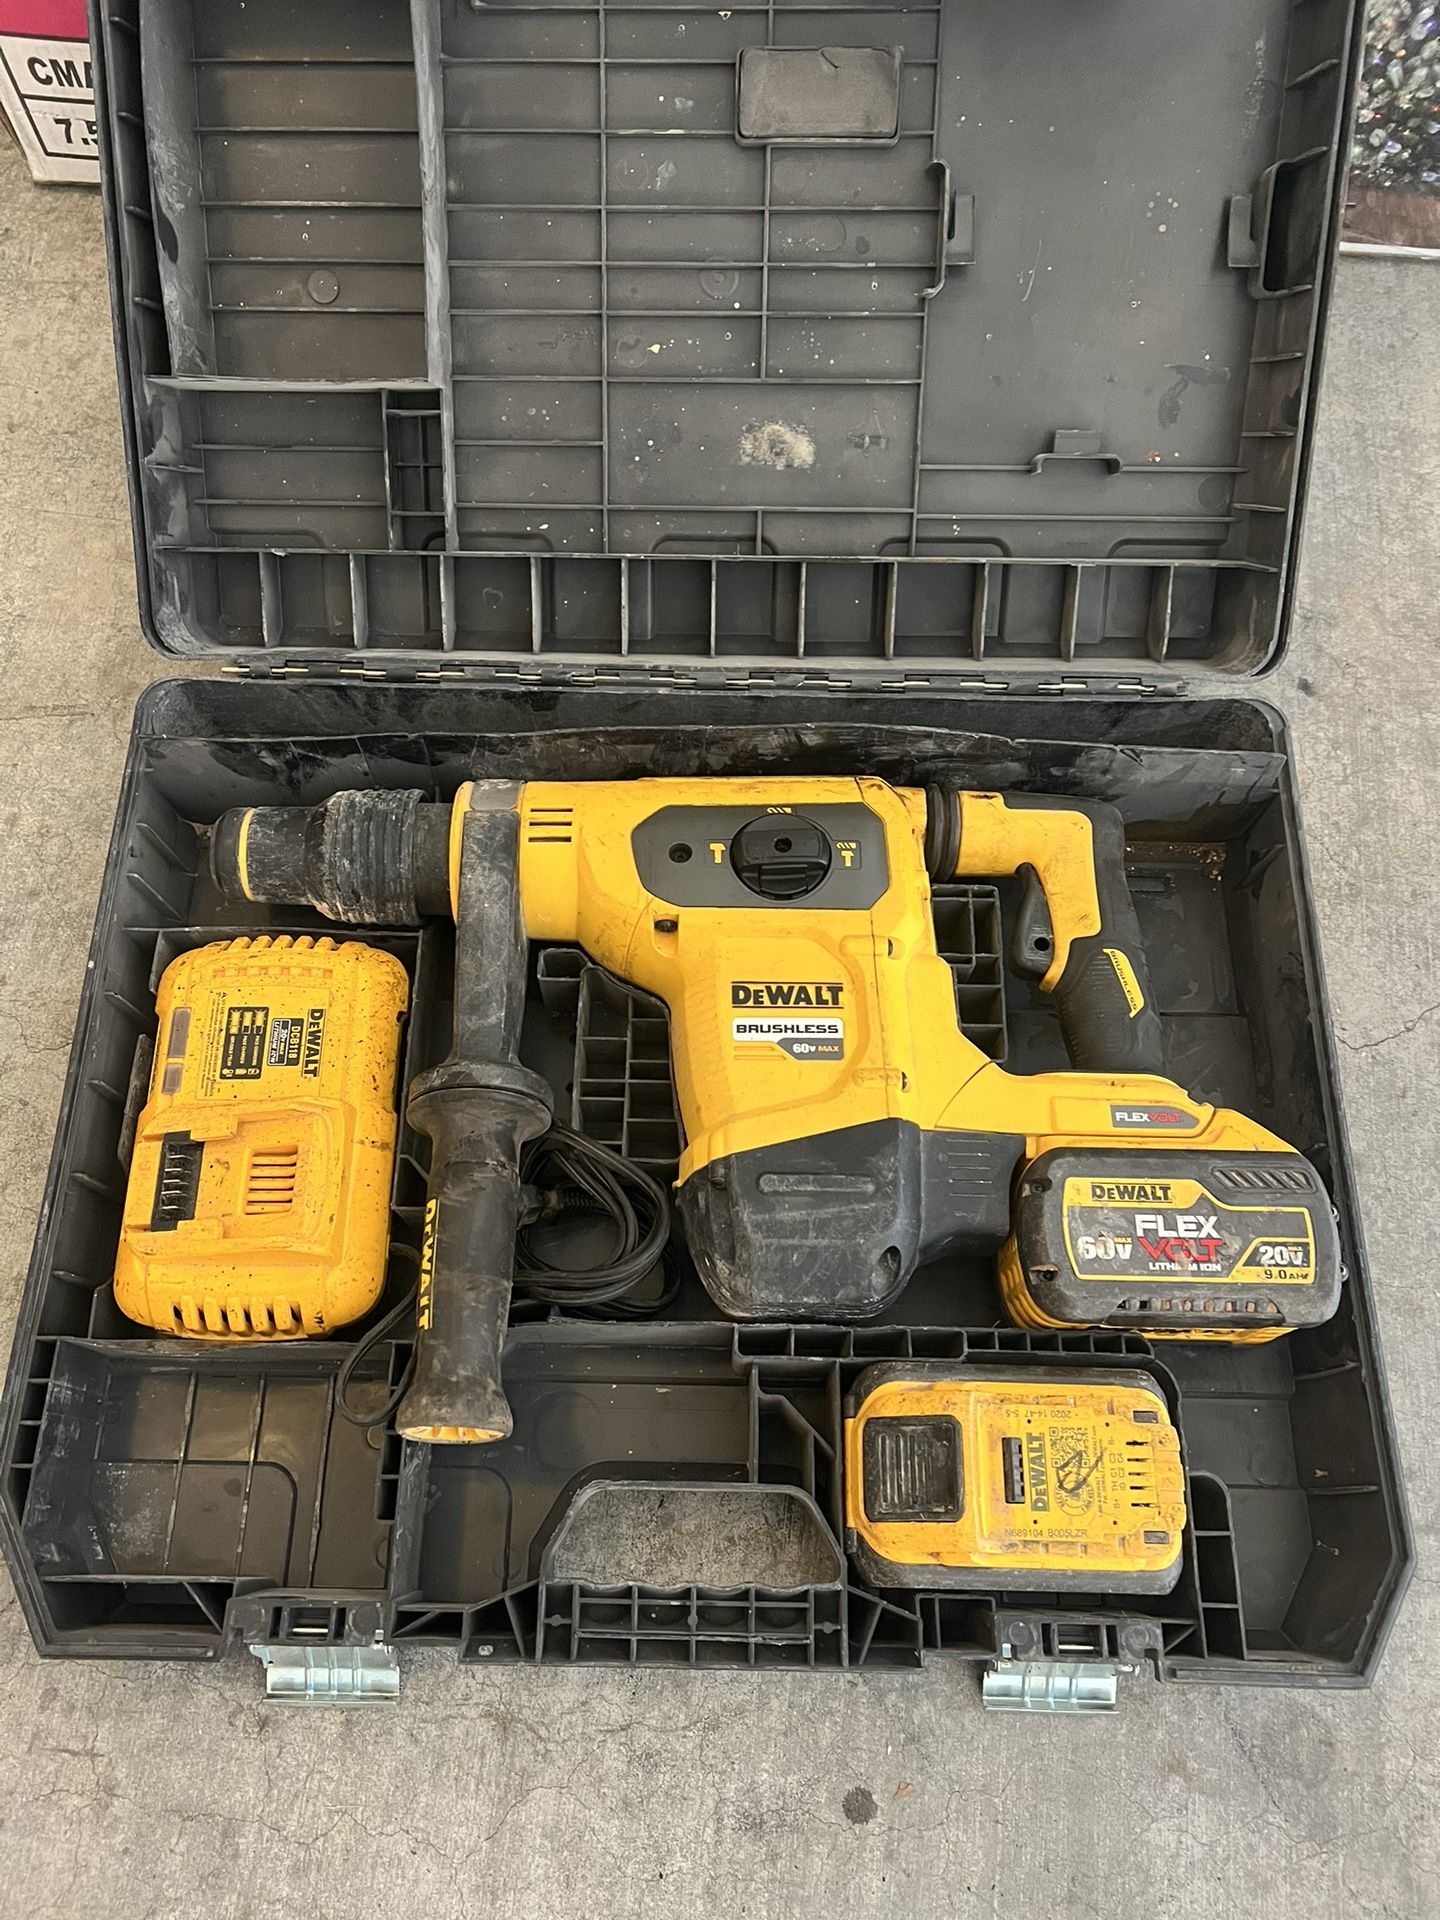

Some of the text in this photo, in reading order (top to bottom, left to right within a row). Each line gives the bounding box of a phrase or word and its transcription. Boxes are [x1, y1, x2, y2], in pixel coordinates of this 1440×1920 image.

[731, 985, 843, 1006] DEWALT
[272, 1021, 281, 1049] LITHIUM
[736, 1024, 839, 1034] BRUSHLESS
[288, 1025, 301, 1059] DCB118
[303, 1009, 324, 1077] DEWALT
[792, 1043, 816, 1054] 60V
[1115, 1111, 1182, 1123] FLEXVOLT
[1091, 1184, 1171, 1201] DEWALT
[1134, 1214, 1221, 1239] FLEX
[1077, 1236, 1133, 1260] 60V
[1138, 1237, 1223, 1263] VOLT
[1259, 1245, 1304, 1266] 20V
[1148, 1262, 1222, 1272] LITHIM ION
[1027, 1432, 1049, 1512] DEWALT
